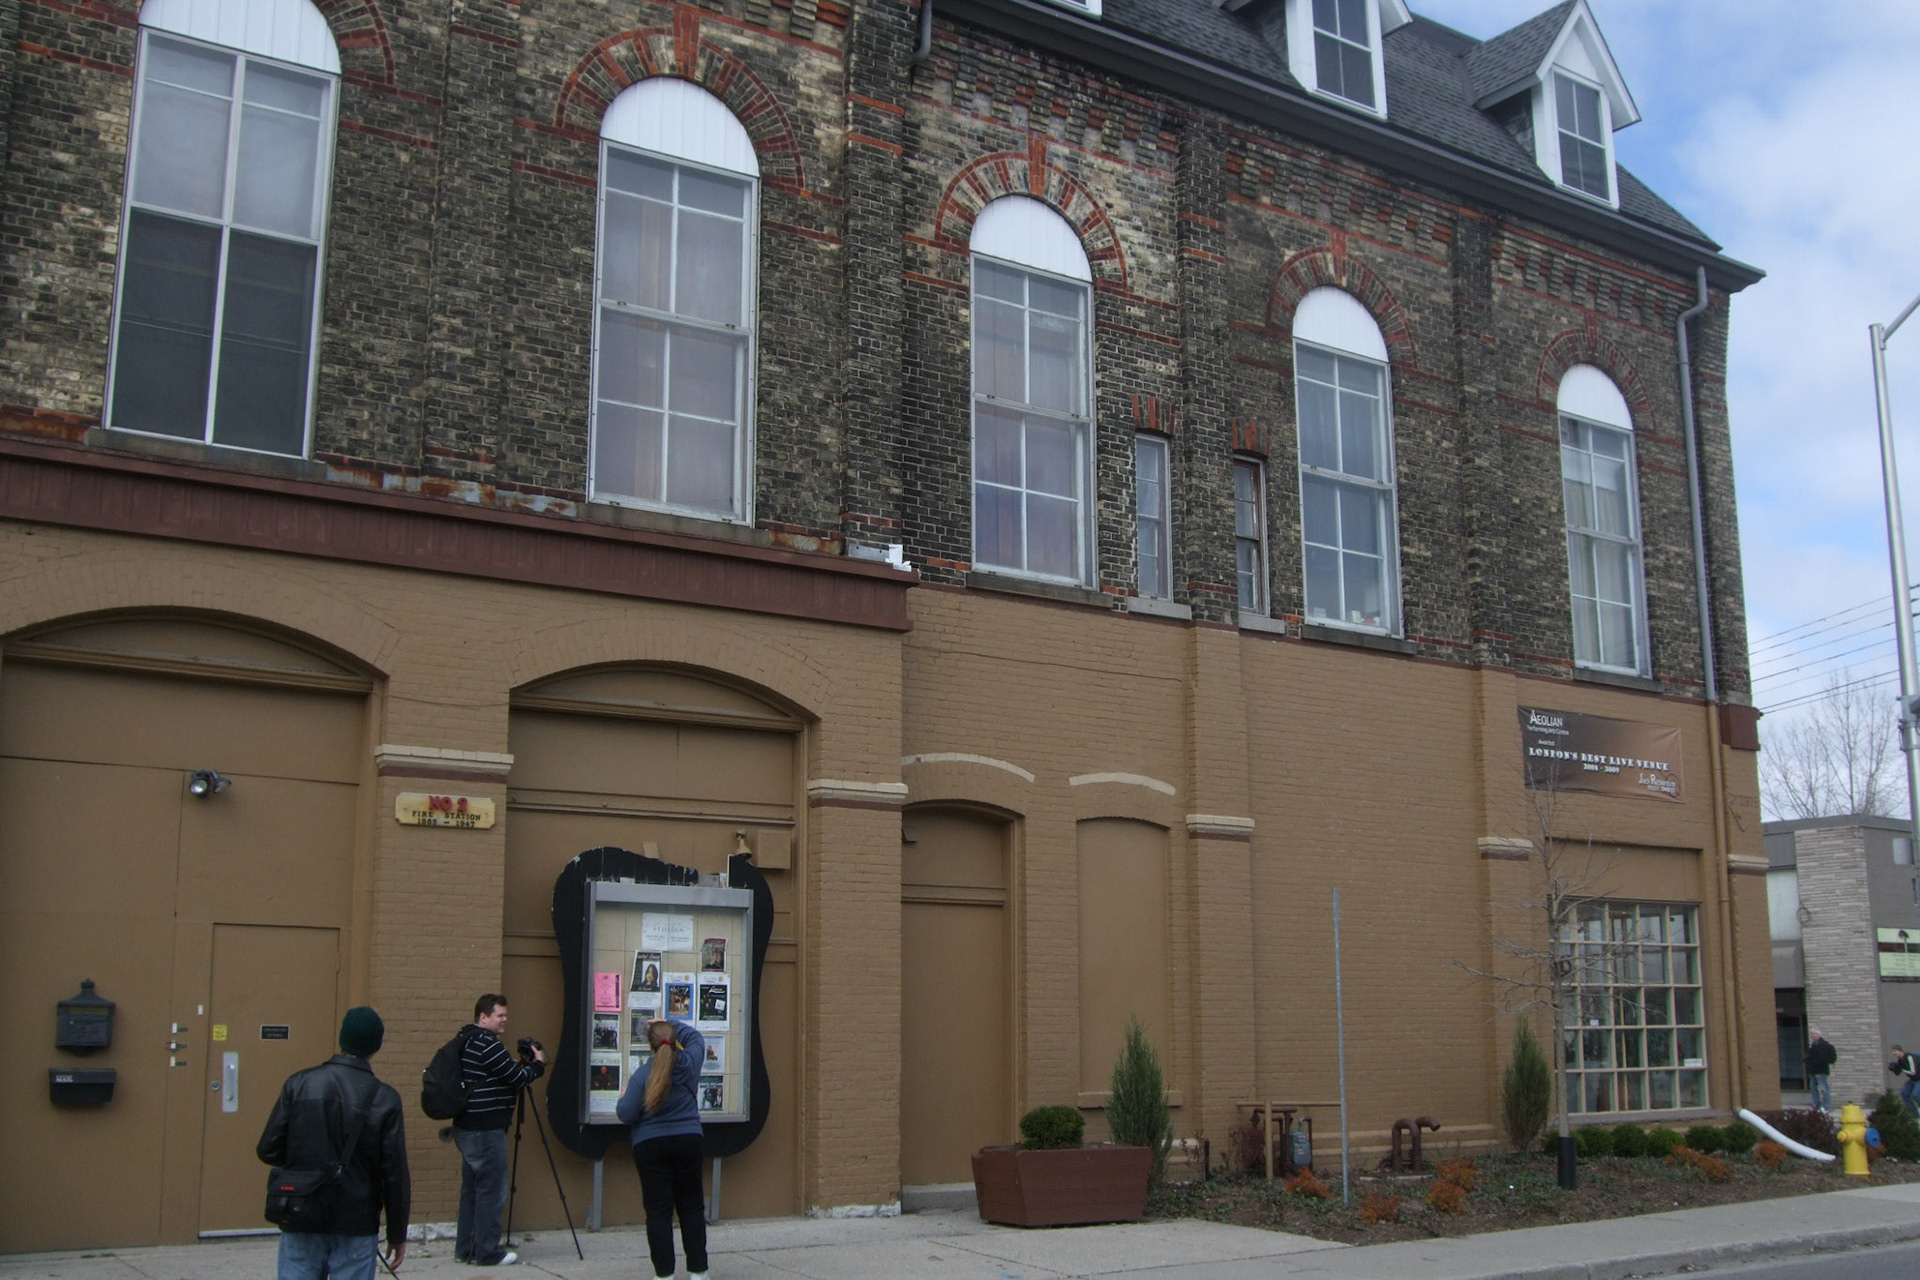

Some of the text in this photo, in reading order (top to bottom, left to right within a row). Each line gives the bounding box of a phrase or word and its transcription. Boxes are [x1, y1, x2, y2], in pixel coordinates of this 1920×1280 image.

[1581, 753, 1606, 764] BEST
[1610, 757, 1635, 767] LIVE
[1637, 760, 1669, 771] VENUE
[429, 795, 468, 812] NO 2
[444, 812, 481, 820] STATION
[456, 820, 475, 828] 1947
